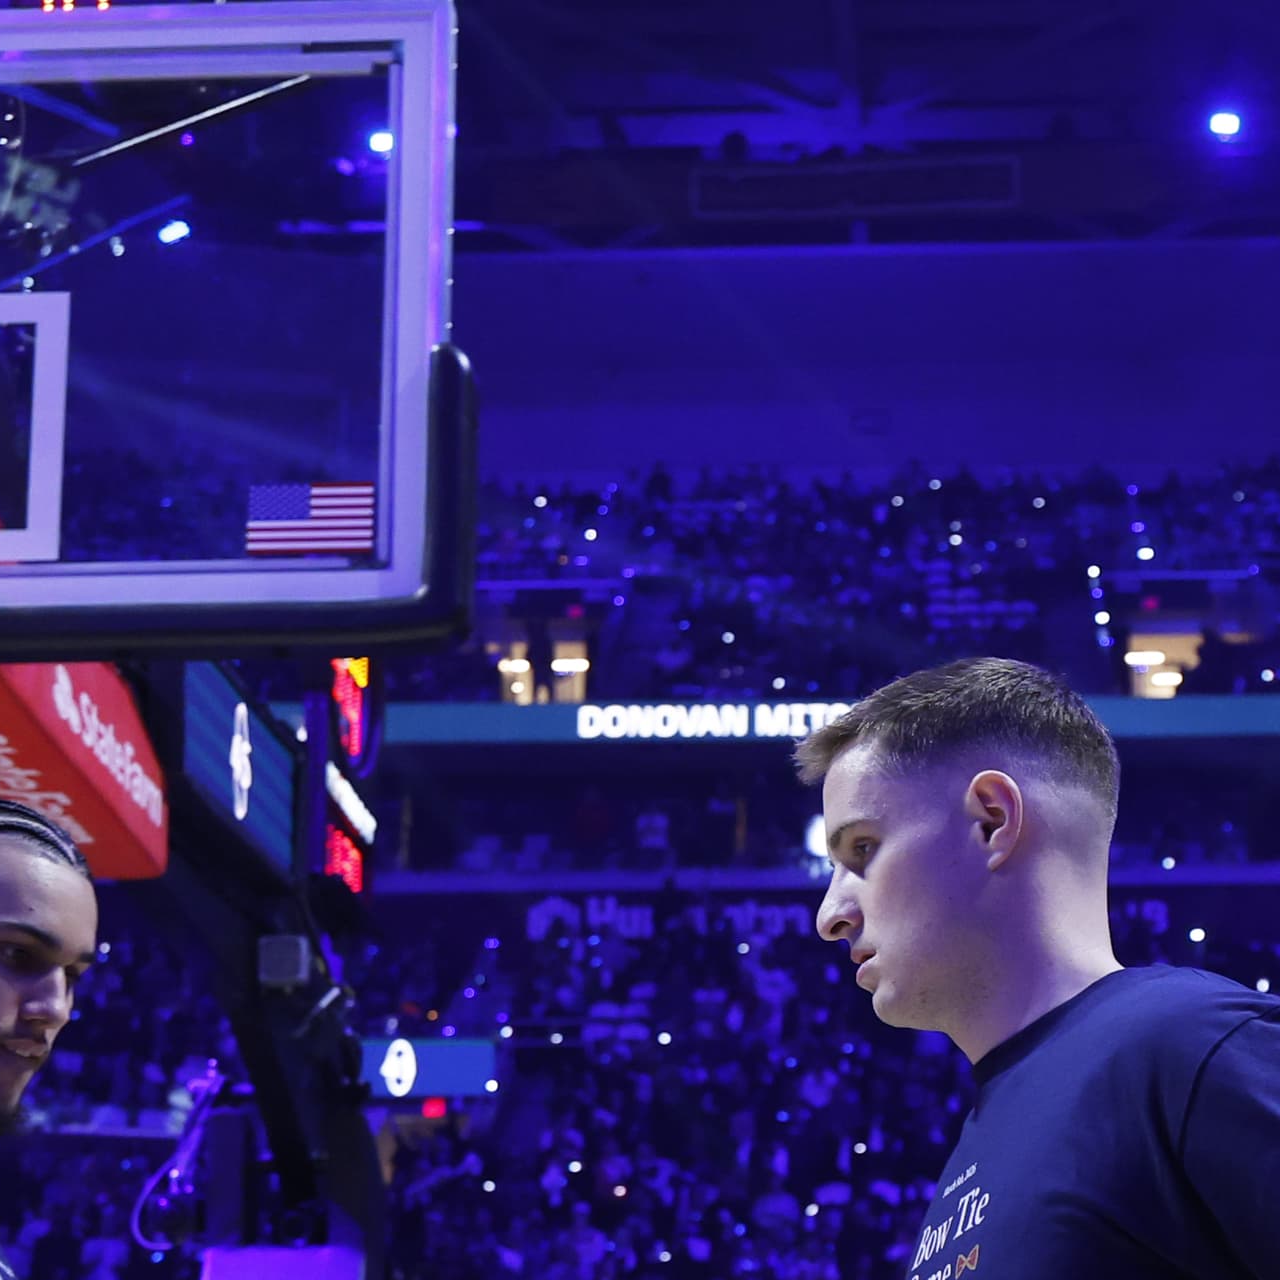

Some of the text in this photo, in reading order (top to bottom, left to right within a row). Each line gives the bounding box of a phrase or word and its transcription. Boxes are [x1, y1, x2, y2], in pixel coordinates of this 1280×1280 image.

[576, 704, 749, 738] DONOVAN
[911, 1186, 990, 1271] Bow Tie
